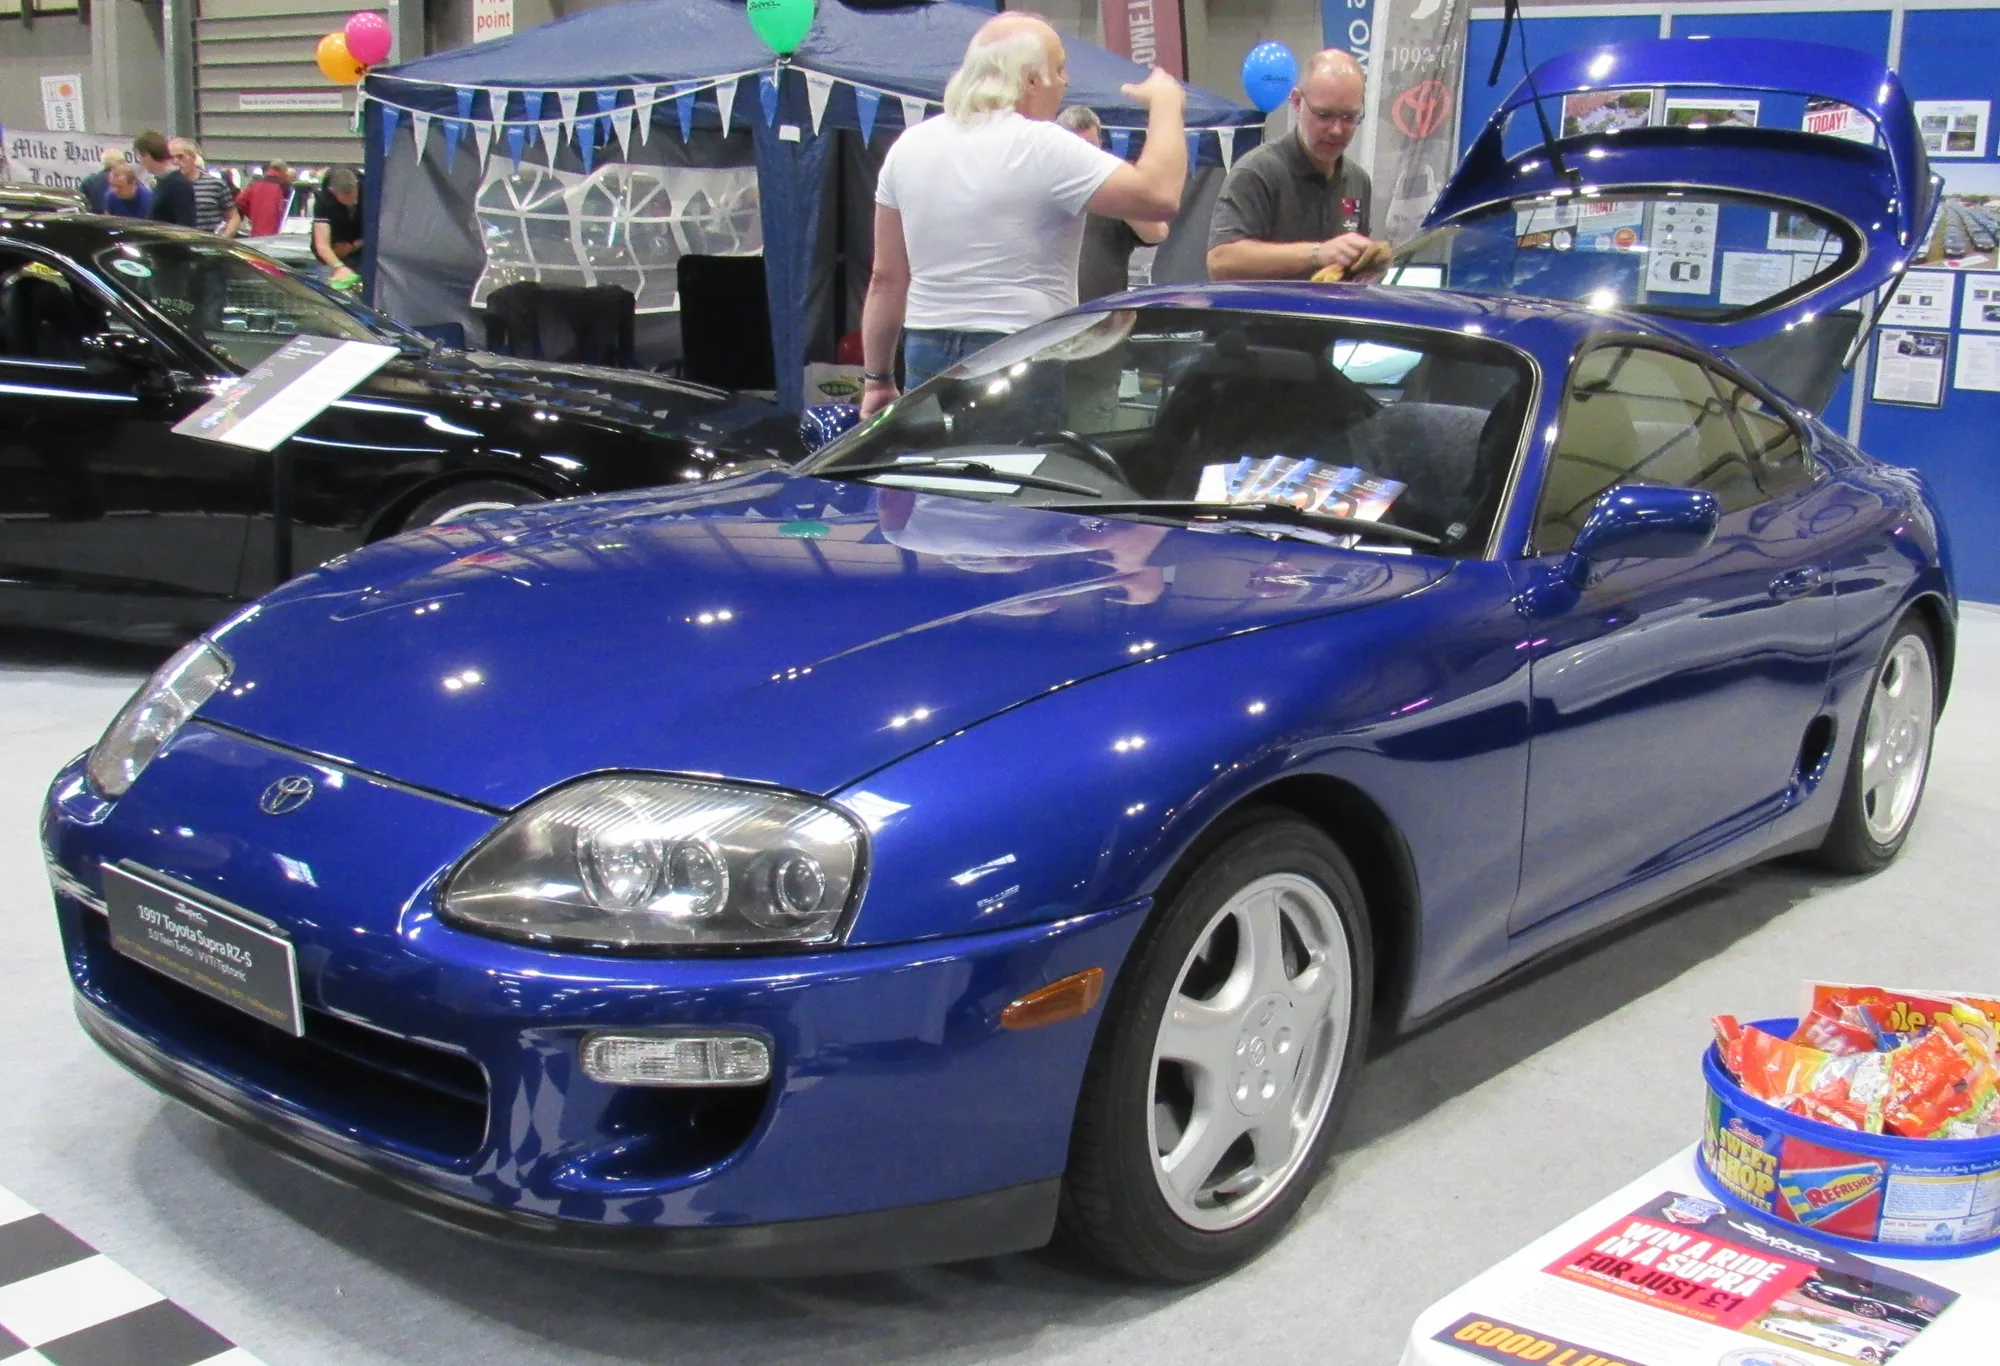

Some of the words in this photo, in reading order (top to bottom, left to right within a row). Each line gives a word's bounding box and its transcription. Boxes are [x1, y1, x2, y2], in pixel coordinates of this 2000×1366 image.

[477, 10, 510, 32] point
[1807, 111, 1848, 133] TODAY!
[12, 138, 58, 160] Mike
[137, 904, 161, 926] 1997
[161, 914, 197, 942] Toyota
[196, 929, 226, 957] Supra
[225, 942, 253, 968] RZ-S
[1719, 1147, 1775, 1200] SHOP
[1720, 1127, 1777, 1176] SWEET
[1804, 1174, 1877, 1209] REFRESHERS
[1622, 1222, 1691, 1251] WIN
[1682, 1242, 1712, 1263] A
[1705, 1247, 1786, 1282] RIDE
[1727, 1220, 1836, 1264] Supra
[1573, 1252, 1634, 1278] FOR
[1629, 1271, 1706, 1301] JUST
[1698, 1291, 1744, 1312] £1
[1586, 1269, 1641, 1291] PROCEEDS
[1595, 1236, 1635, 1258] IN
[1631, 1247, 1657, 1266] A
[1656, 1253, 1762, 1297] SUPRA
[1453, 1320, 1557, 1361] GOOD
